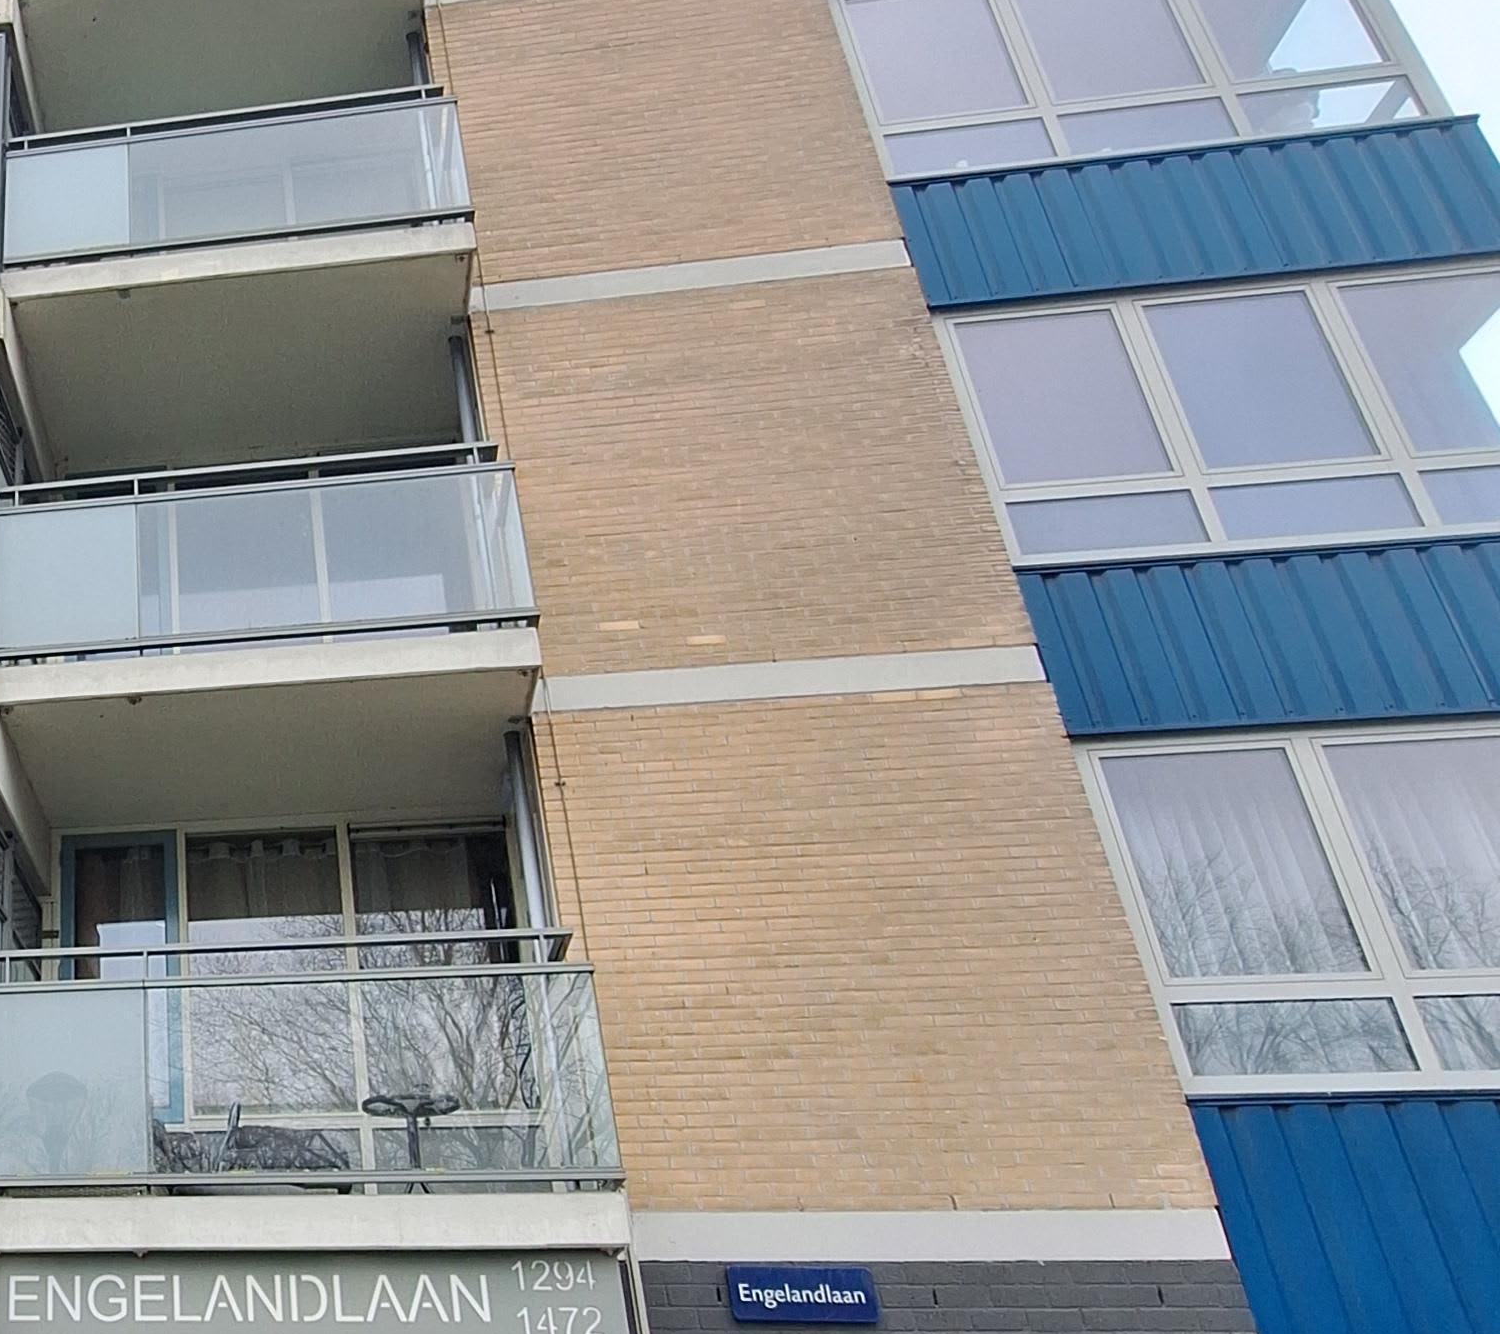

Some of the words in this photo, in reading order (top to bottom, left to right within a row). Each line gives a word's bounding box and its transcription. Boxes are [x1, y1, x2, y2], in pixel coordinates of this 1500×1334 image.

[510, 1259, 597, 1292] 1294
[8, 1274, 492, 1323] ENGELANDLAAN
[738, 1283, 866, 1308] Engelandlaan
